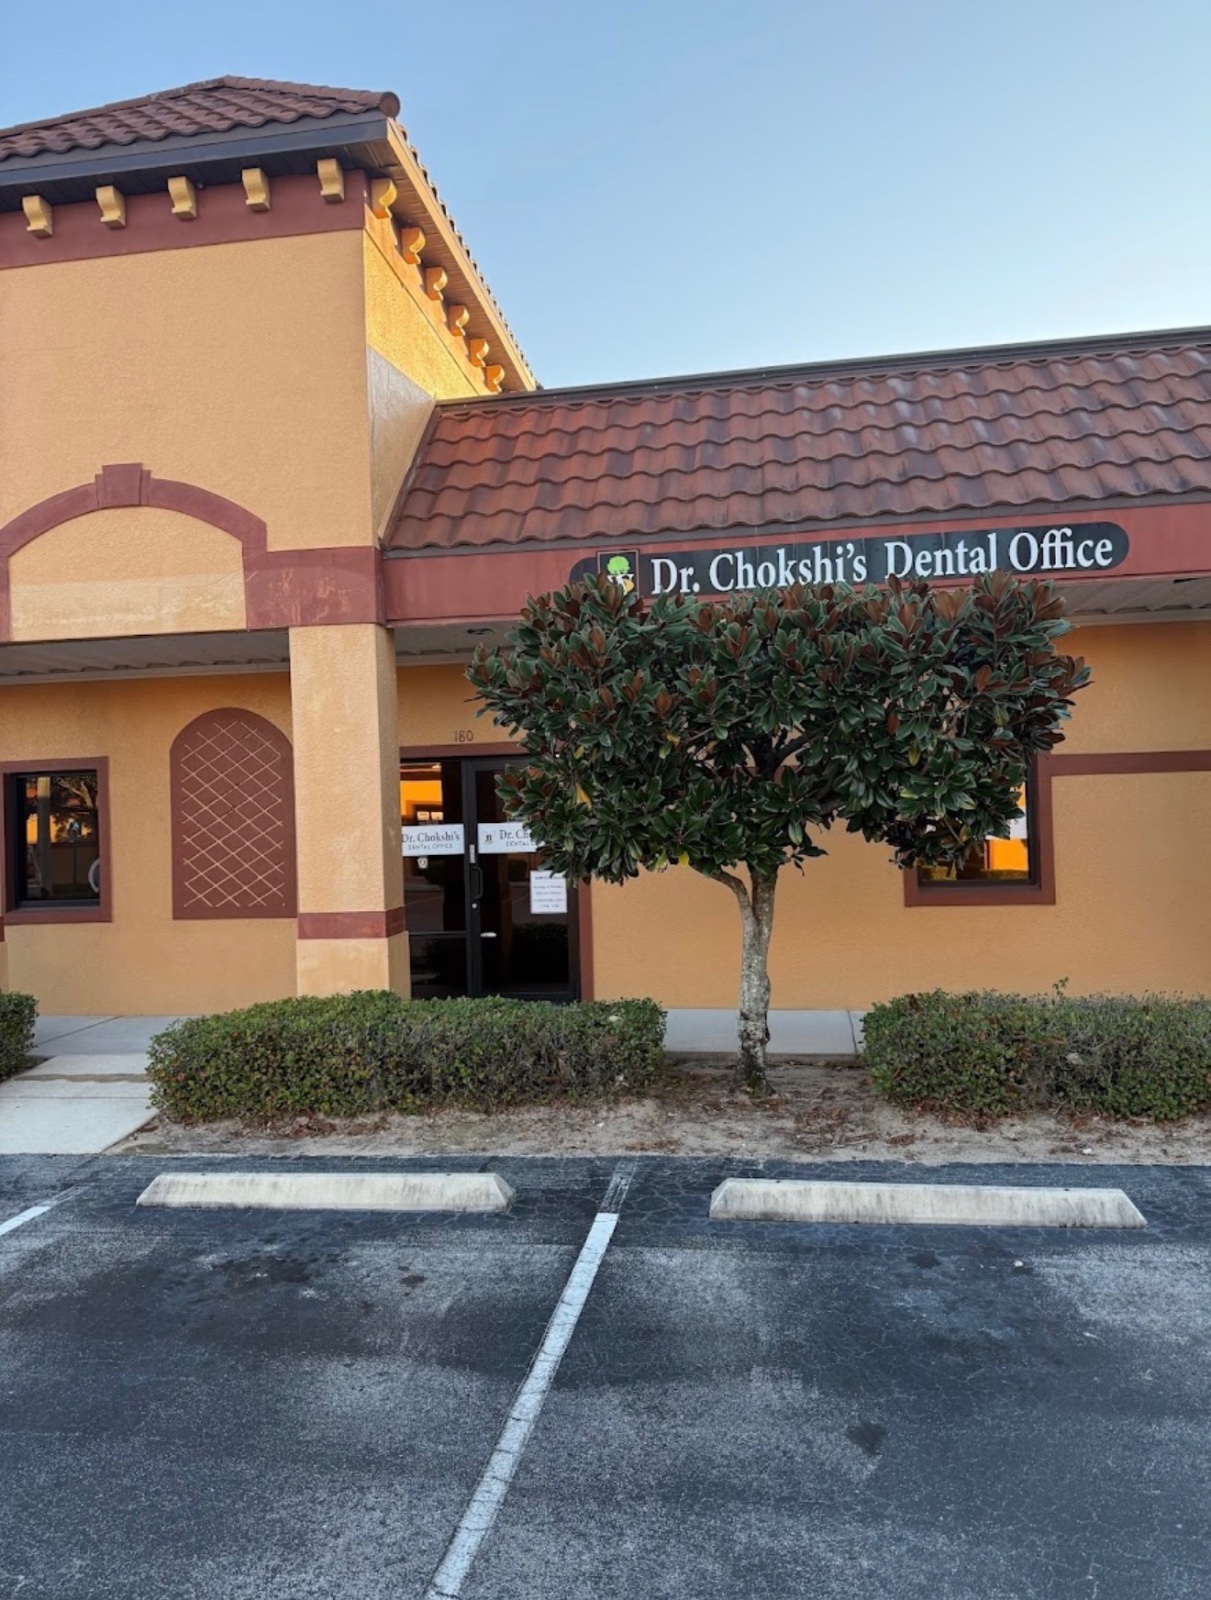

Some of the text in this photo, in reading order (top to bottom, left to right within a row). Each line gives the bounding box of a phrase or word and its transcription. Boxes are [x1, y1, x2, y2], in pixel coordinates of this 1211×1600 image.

[650, 527, 1113, 595] Dr. Chokshi's Dental Office
[453, 730, 474, 742] 180
[401, 831, 460, 843] Dr. Chokshi's
[499, 829, 514, 840] Dr.
